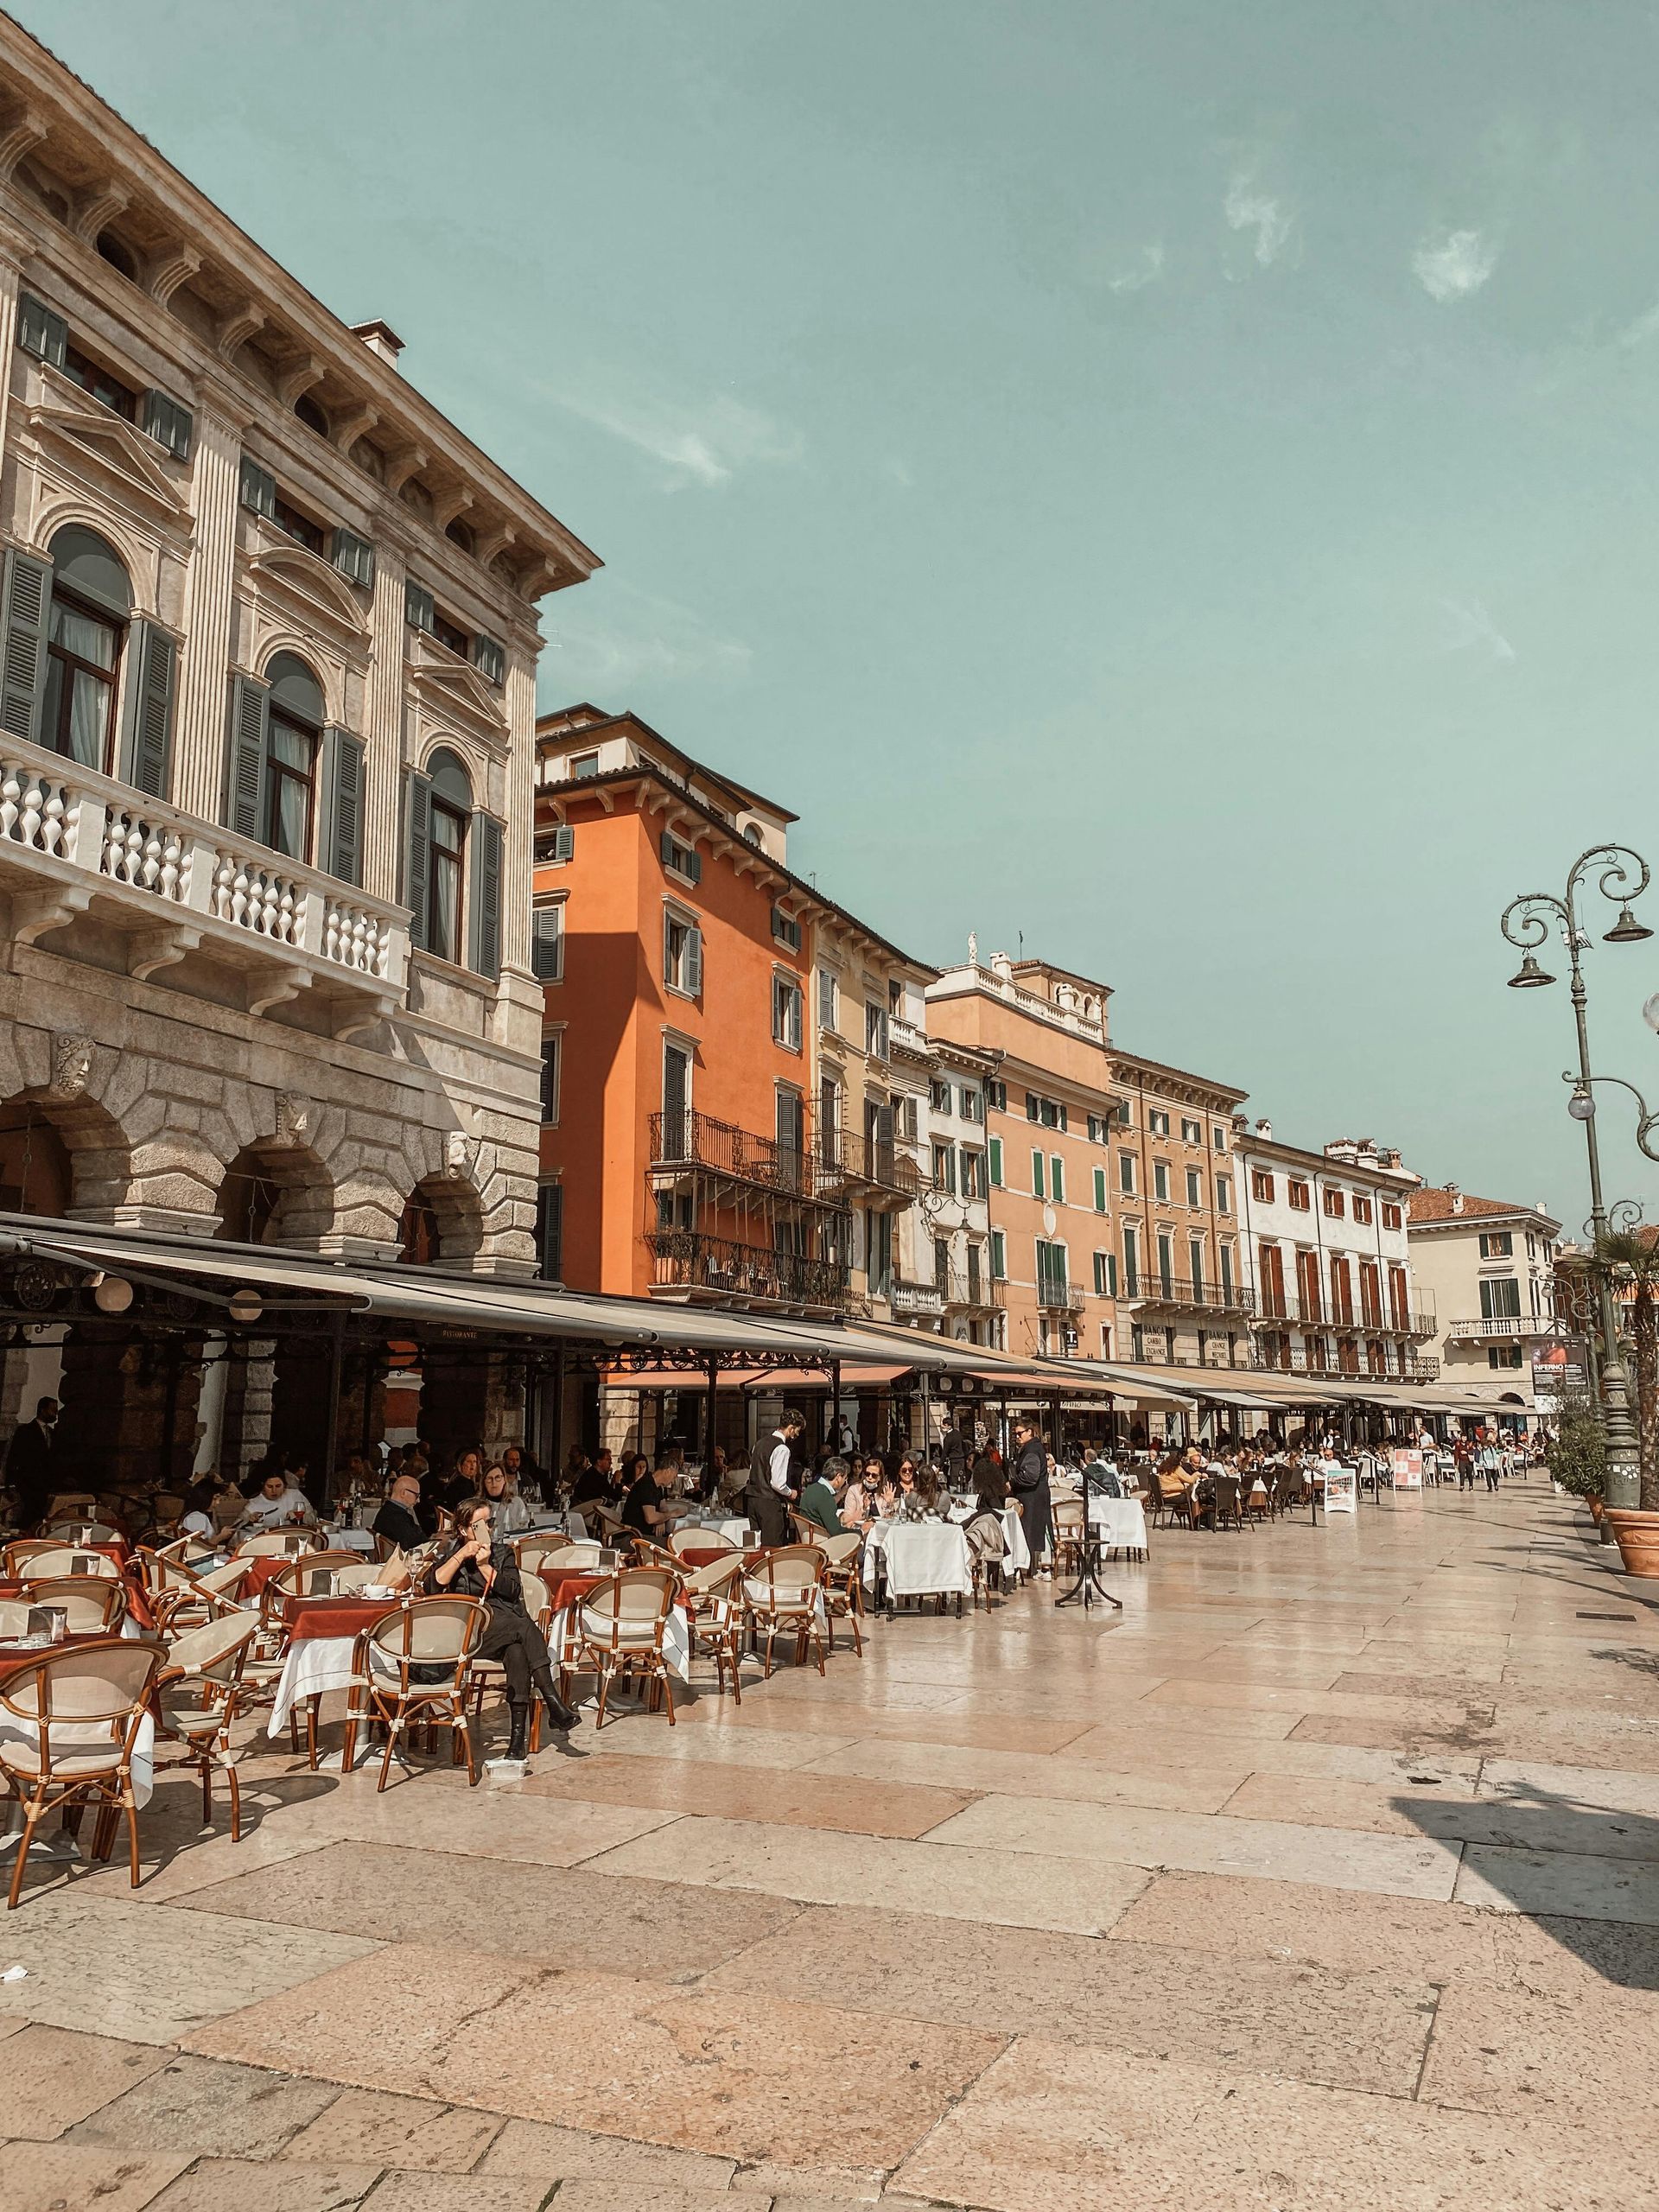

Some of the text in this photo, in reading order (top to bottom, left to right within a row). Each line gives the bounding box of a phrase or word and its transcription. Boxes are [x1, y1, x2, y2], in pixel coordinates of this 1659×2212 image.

[442, 1330, 477, 1338] RISTORANTE
[1144, 1325, 1166, 1336] BANCA
[1067, 1332, 1076, 1343] T
[1209, 1331, 1227, 1340] BANCA
[1147, 1347, 1166, 1356] EXCHANGE
